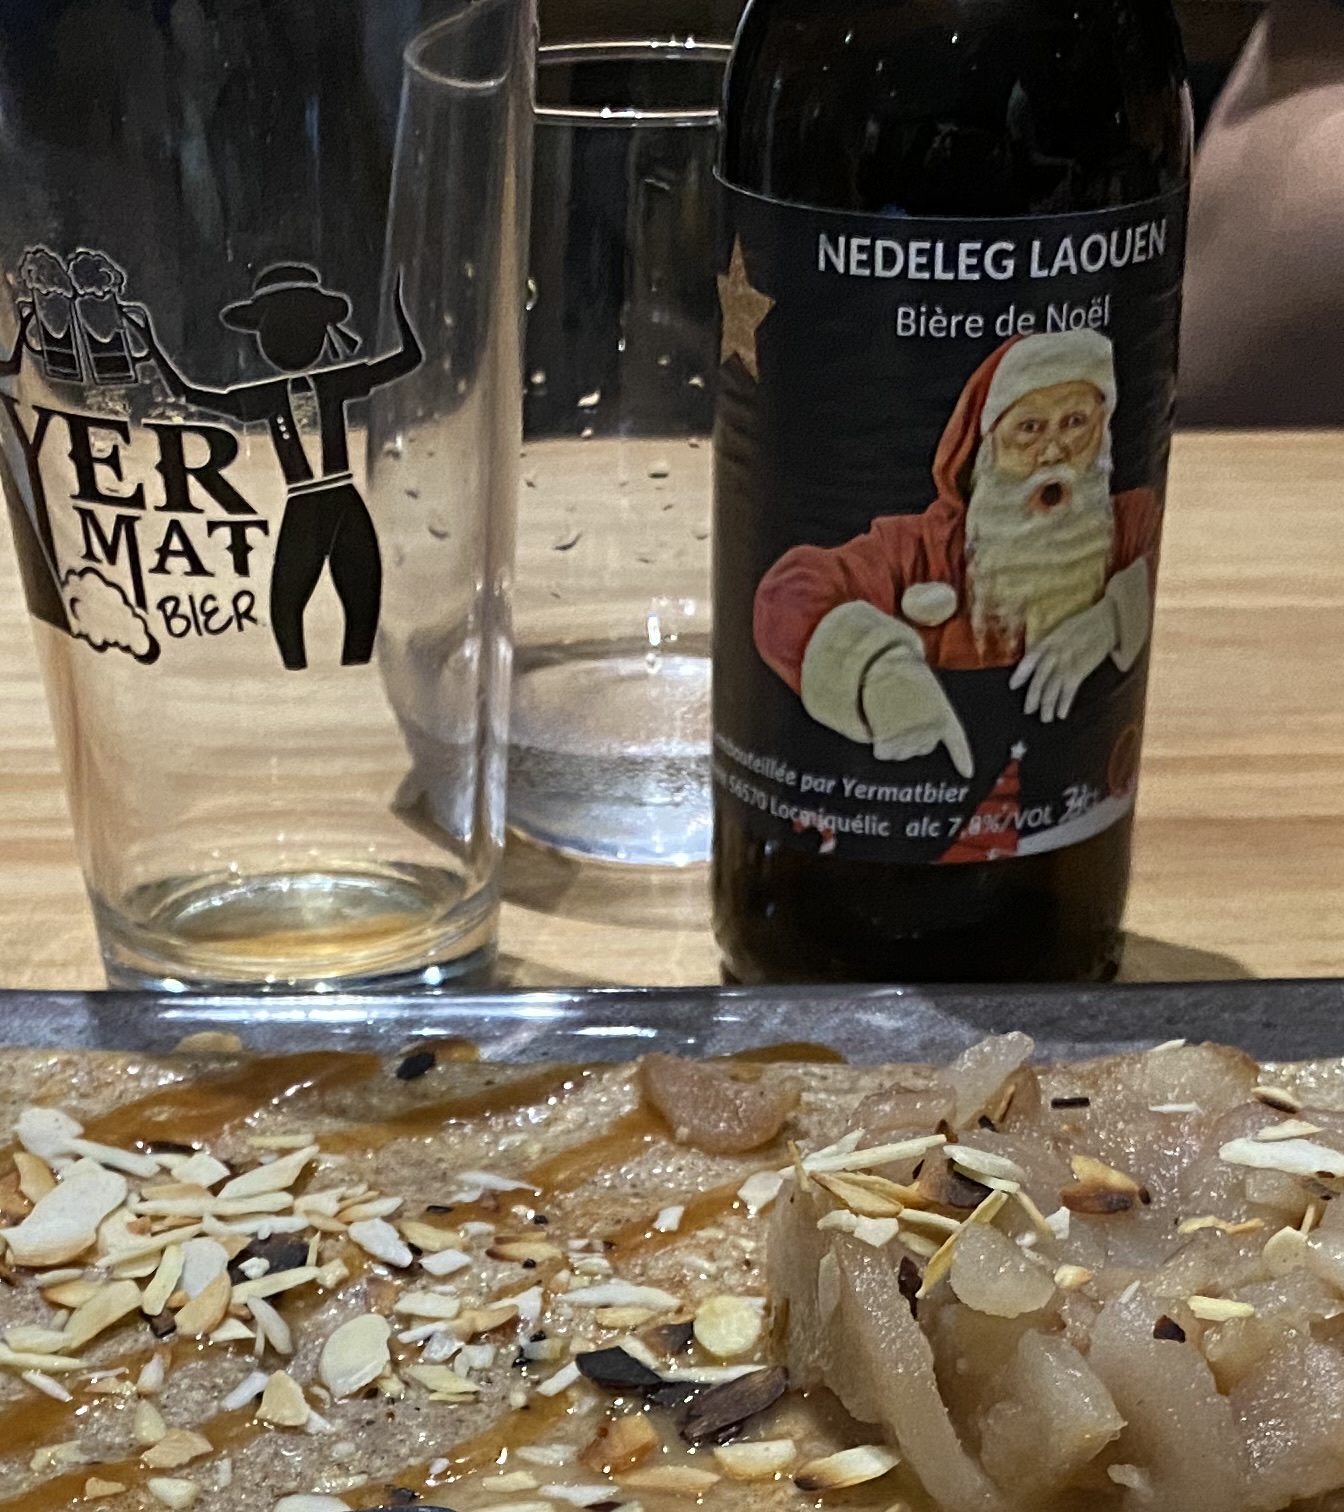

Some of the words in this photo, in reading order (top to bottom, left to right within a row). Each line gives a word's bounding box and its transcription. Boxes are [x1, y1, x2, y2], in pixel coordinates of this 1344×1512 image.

[817, 231, 1014, 281] NEDELEG
[1029, 218, 1167, 279] LAOUEN
[896, 303, 984, 338] Bière
[995, 304, 1035, 337] de
[1046, 294, 1111, 335] Noël
[0, 394, 259, 580] YER
[72, 504, 269, 612] MAT
[156, 589, 263, 640] BIER
[800, 773, 837, 793] par
[842, 777, 970, 805] Yermatbier
[770, 795, 891, 837] Locmiquélic
[905, 816, 942, 838] alc
